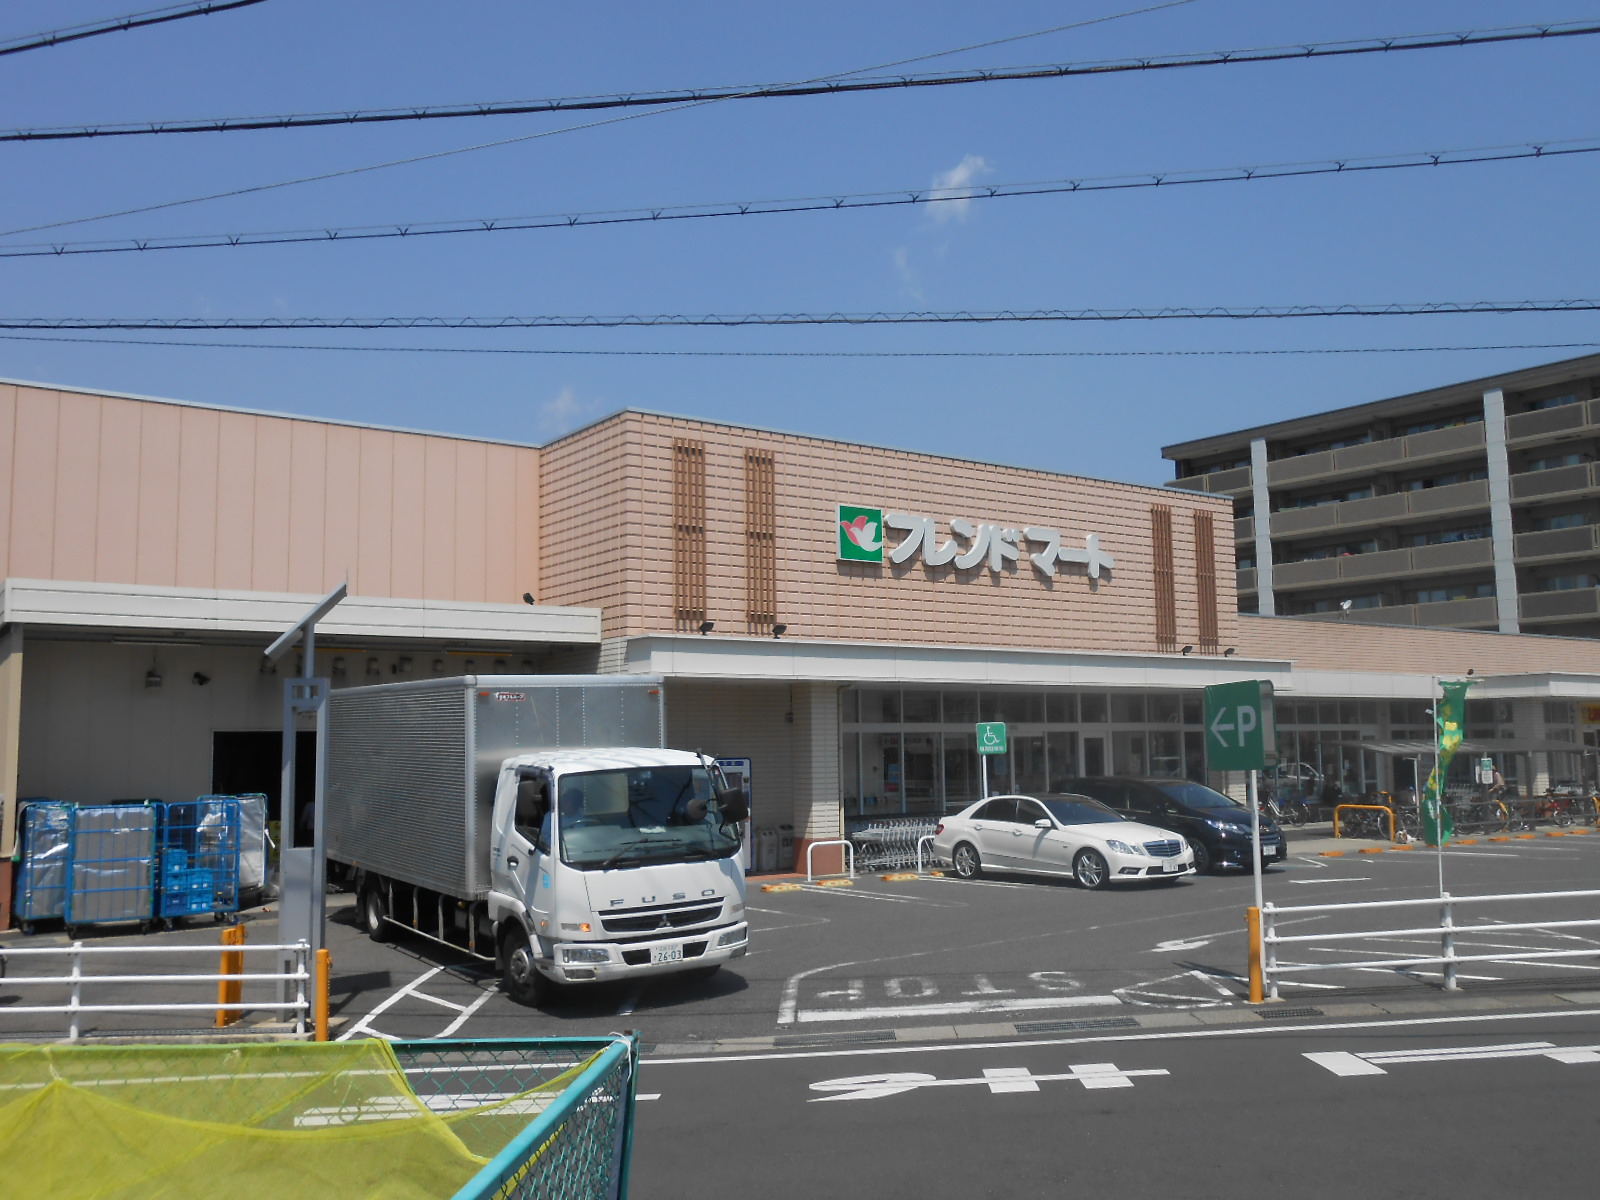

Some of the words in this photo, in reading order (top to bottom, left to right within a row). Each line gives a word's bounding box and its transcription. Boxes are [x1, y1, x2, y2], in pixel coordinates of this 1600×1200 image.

[884, 513, 1116, 579] フレンドマート
[1237, 705, 1257, 747] P
[610, 889, 715, 906] FUSO
[816, 971, 1081, 1000] STOP
